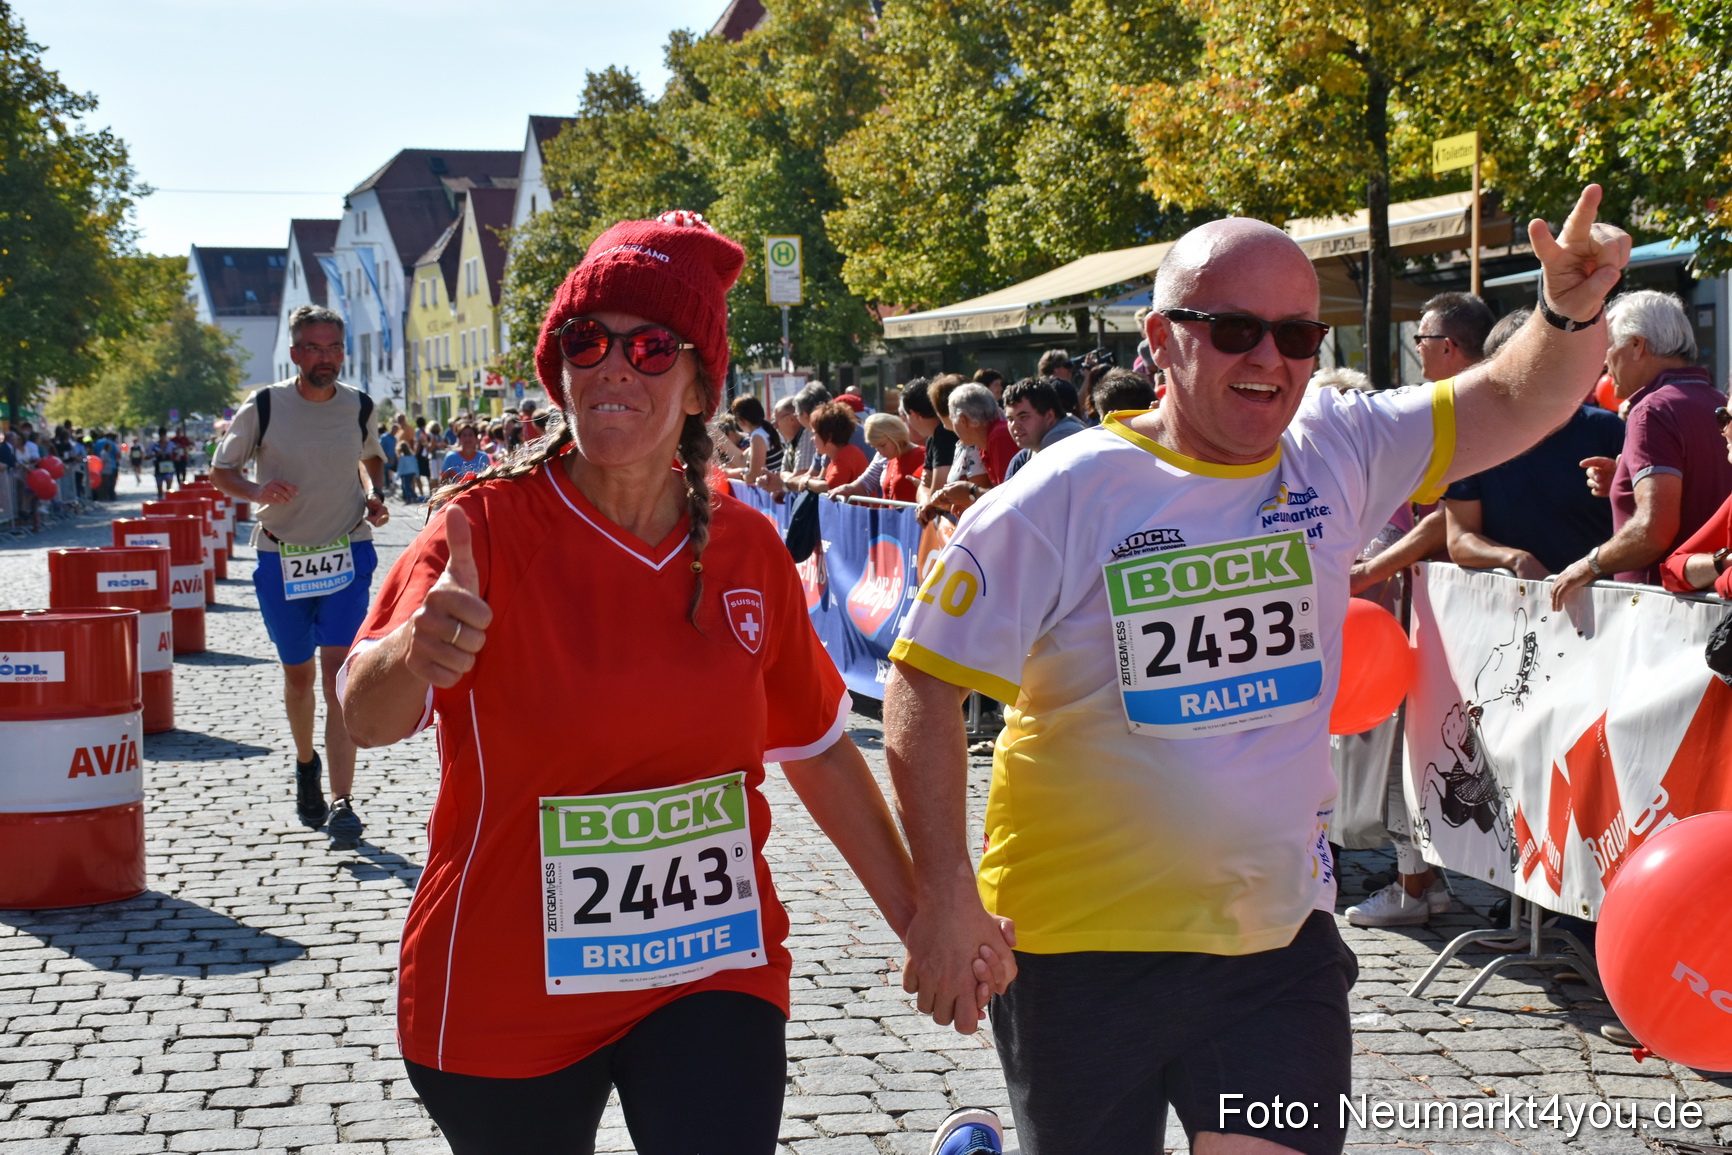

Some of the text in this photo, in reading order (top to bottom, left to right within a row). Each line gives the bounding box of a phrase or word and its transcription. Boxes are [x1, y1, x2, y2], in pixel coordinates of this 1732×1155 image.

[290, 553, 344, 578] 2447
[293, 575, 348, 593] REINHARD
[1123, 542, 1296, 604] BOCK
[730, 598, 760, 608] SUISSE
[1141, 601, 1295, 679] 2433
[0, 660, 48, 676] ÖDL
[1179, 678, 1278, 718] RALPH
[67, 733, 139, 779] AVIA
[560, 785, 730, 846] BOCK
[572, 846, 733, 925] 2443
[582, 924, 731, 969] BRIGITTE
